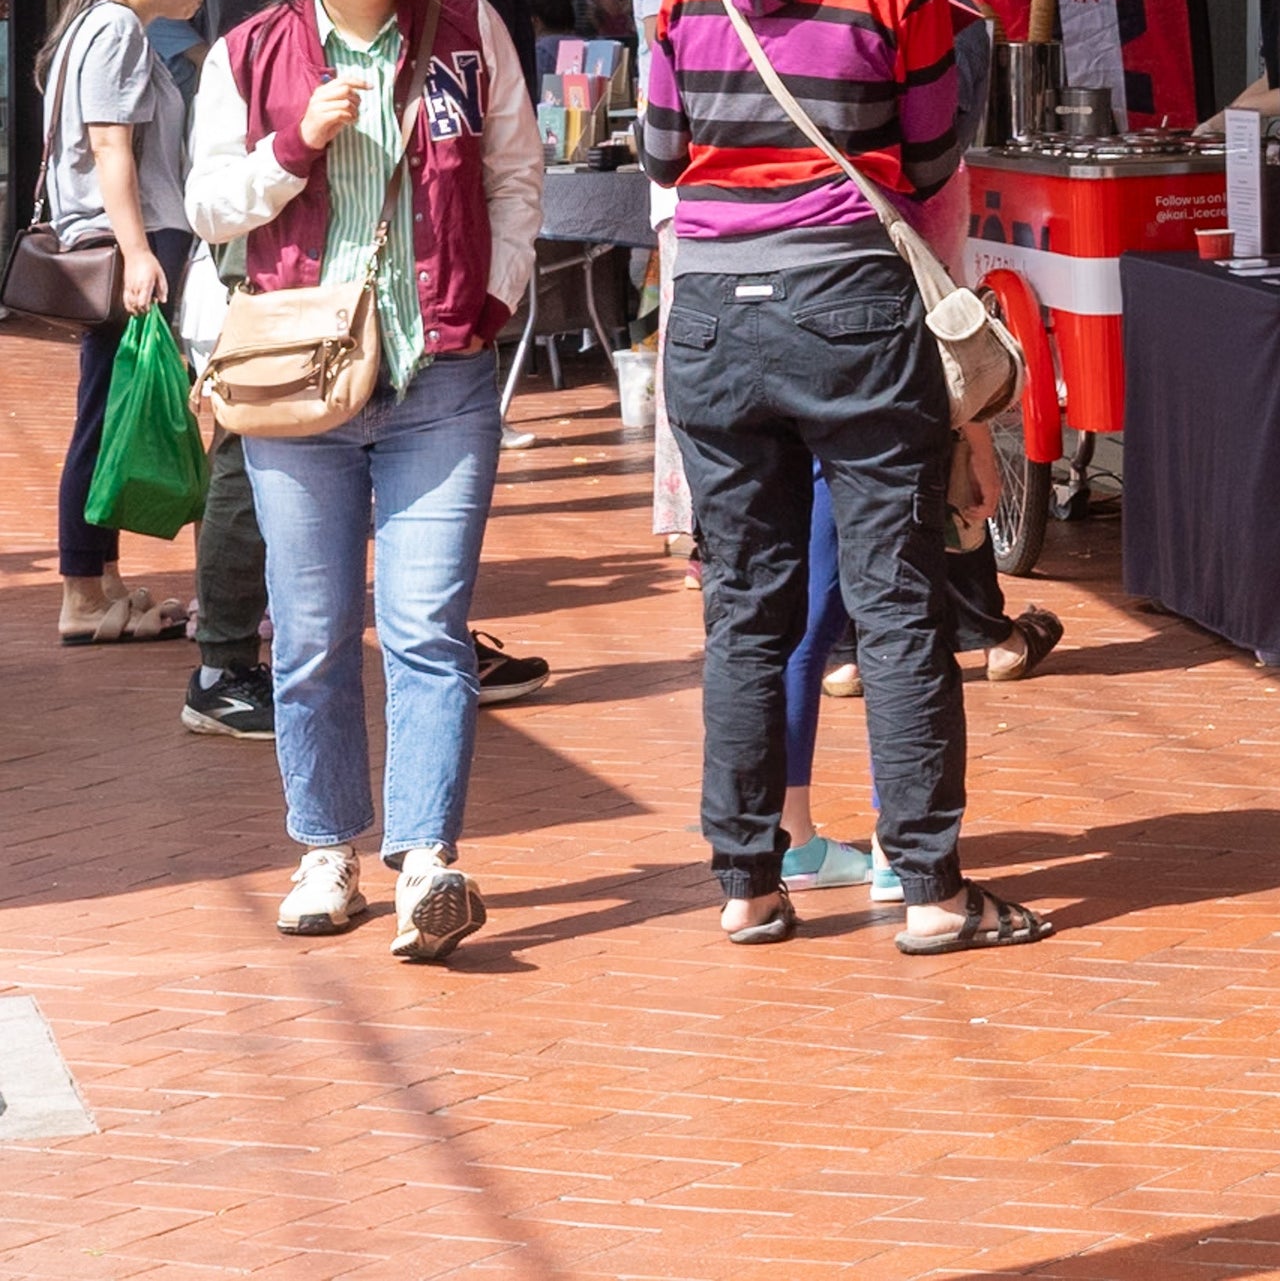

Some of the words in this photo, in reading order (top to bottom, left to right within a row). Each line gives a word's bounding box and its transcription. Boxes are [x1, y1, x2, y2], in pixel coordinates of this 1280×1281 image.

[1155, 194, 1191, 207] Follow
[1193, 195, 1206, 205] us
[1207, 194, 1221, 204] on
